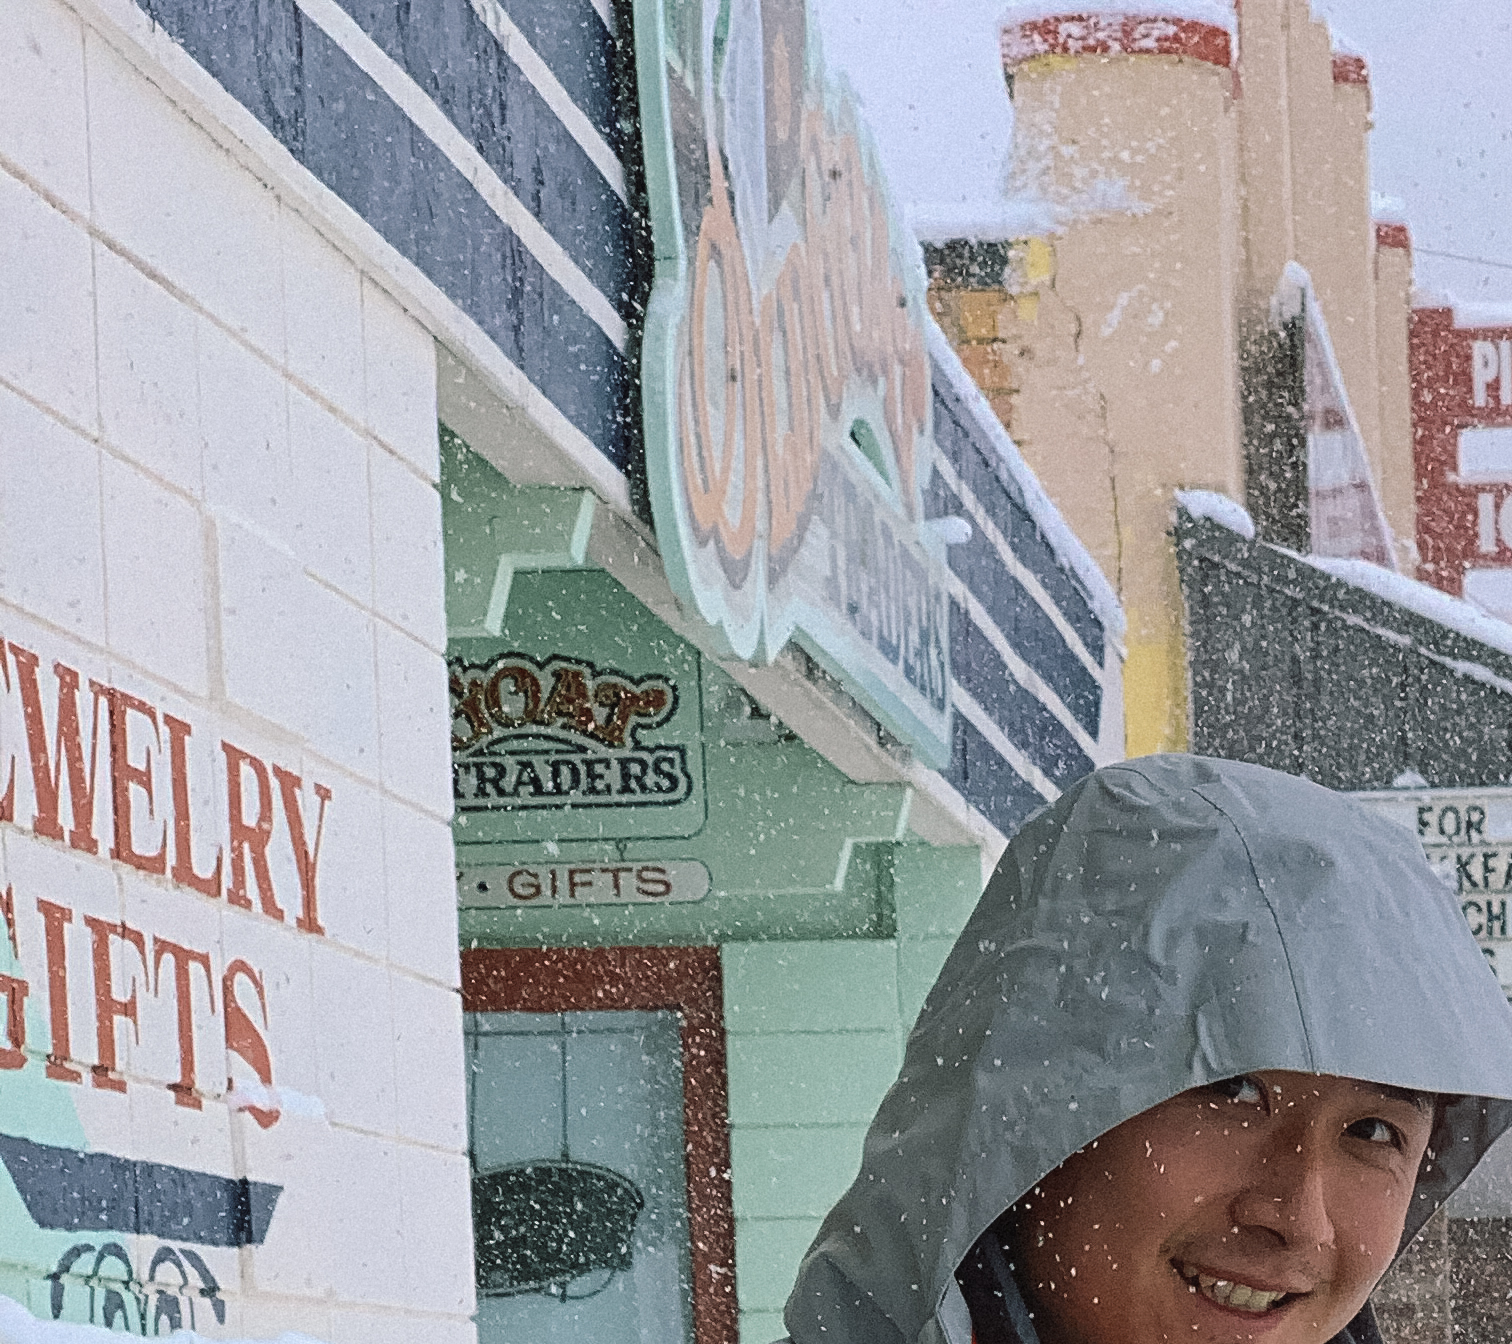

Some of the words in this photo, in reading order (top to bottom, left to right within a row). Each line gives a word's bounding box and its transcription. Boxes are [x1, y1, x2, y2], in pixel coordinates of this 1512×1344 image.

[0, 636, 332, 936] WELRY
[1417, 805, 1487, 845] FOR
[507, 866, 672, 900] GIFTS
